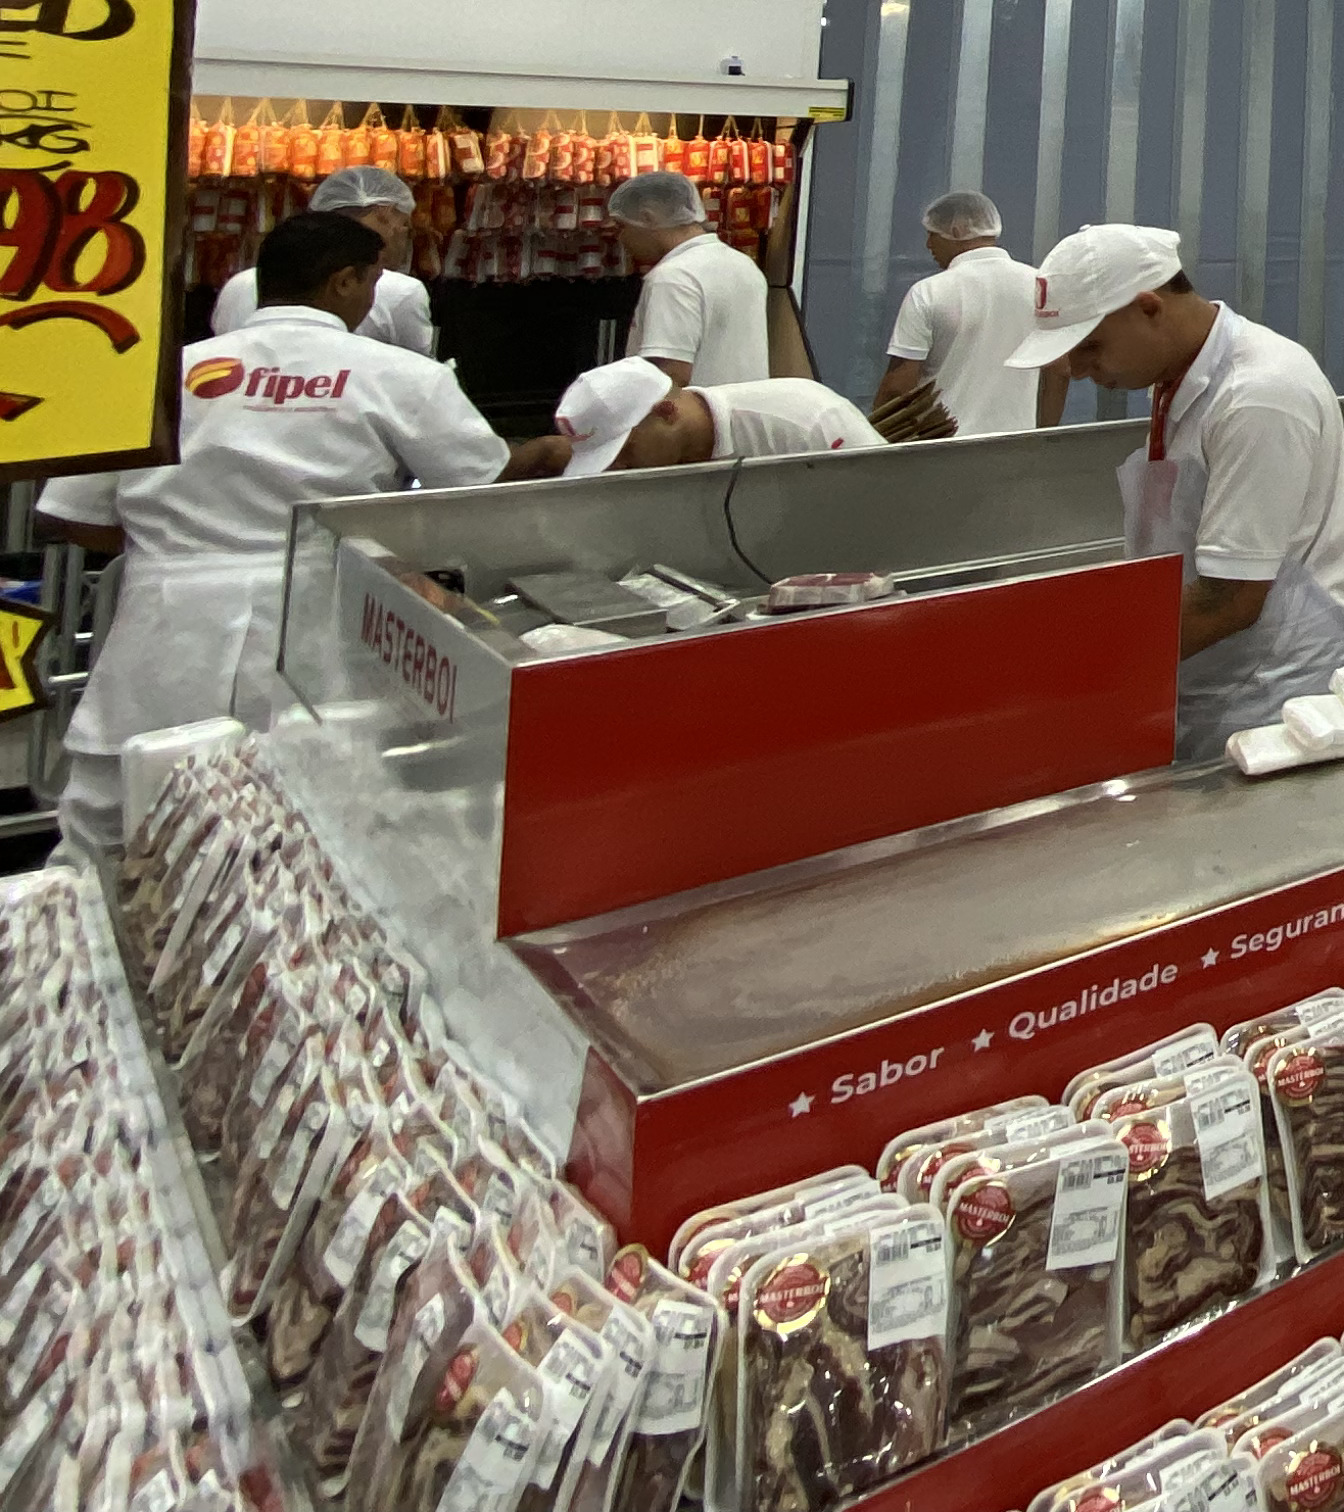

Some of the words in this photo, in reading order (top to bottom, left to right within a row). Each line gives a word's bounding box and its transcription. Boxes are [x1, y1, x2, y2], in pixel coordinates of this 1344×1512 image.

[245, 366, 352, 405] fipel
[362, 593, 459, 724] MASTERBOI
[830, 1046, 945, 1106] Sabor
[1007, 959, 1180, 1043] Qualidade
